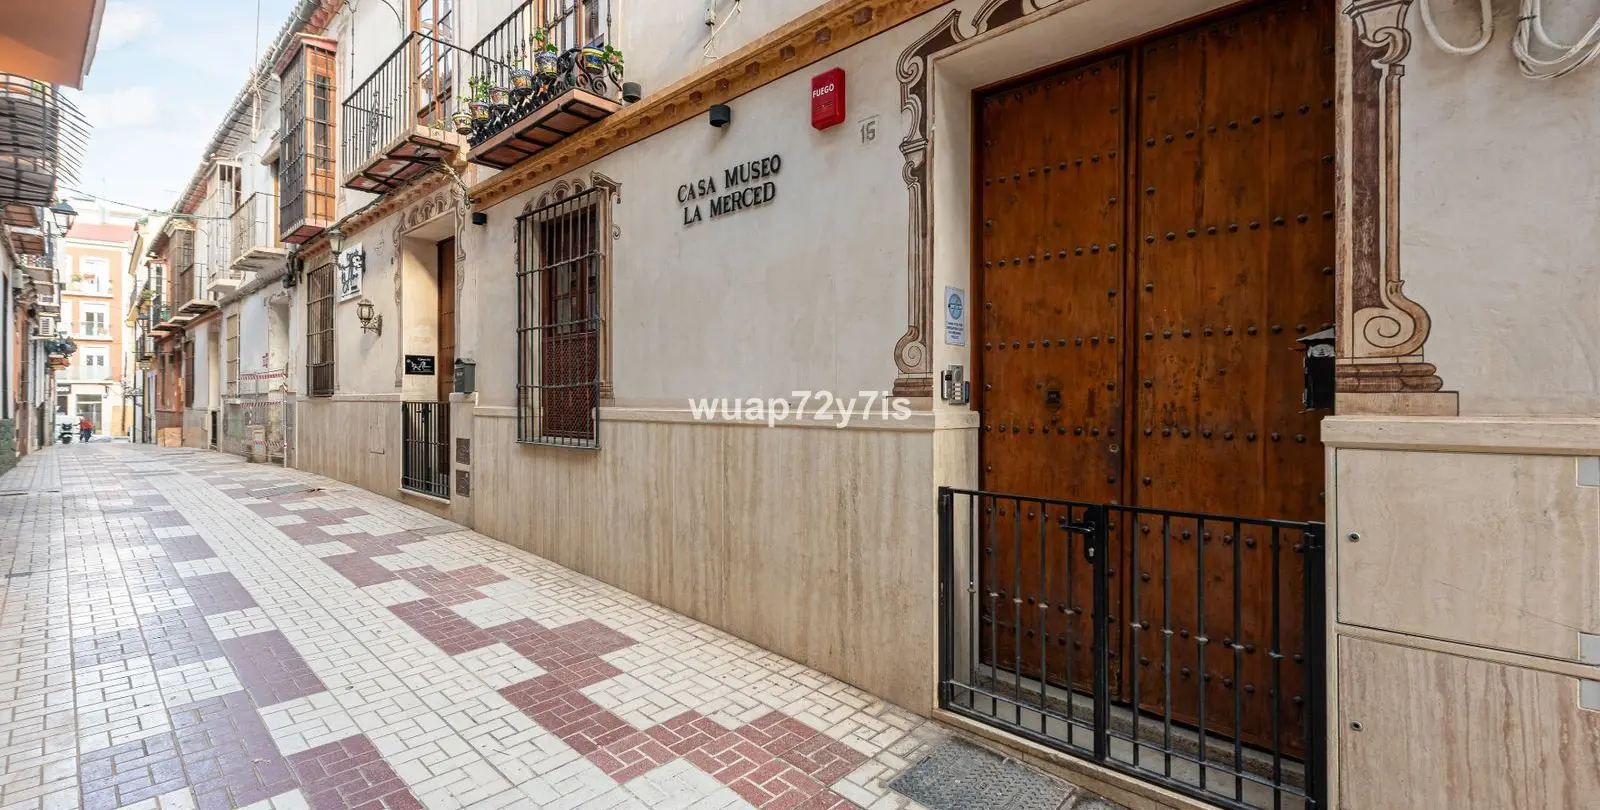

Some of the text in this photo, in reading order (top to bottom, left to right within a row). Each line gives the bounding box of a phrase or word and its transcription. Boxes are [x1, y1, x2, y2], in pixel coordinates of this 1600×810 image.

[812, 83, 835, 99] FUEGO
[677, 154, 781, 203] CASA MUSEO
[683, 181, 776, 225] LA MERCED
